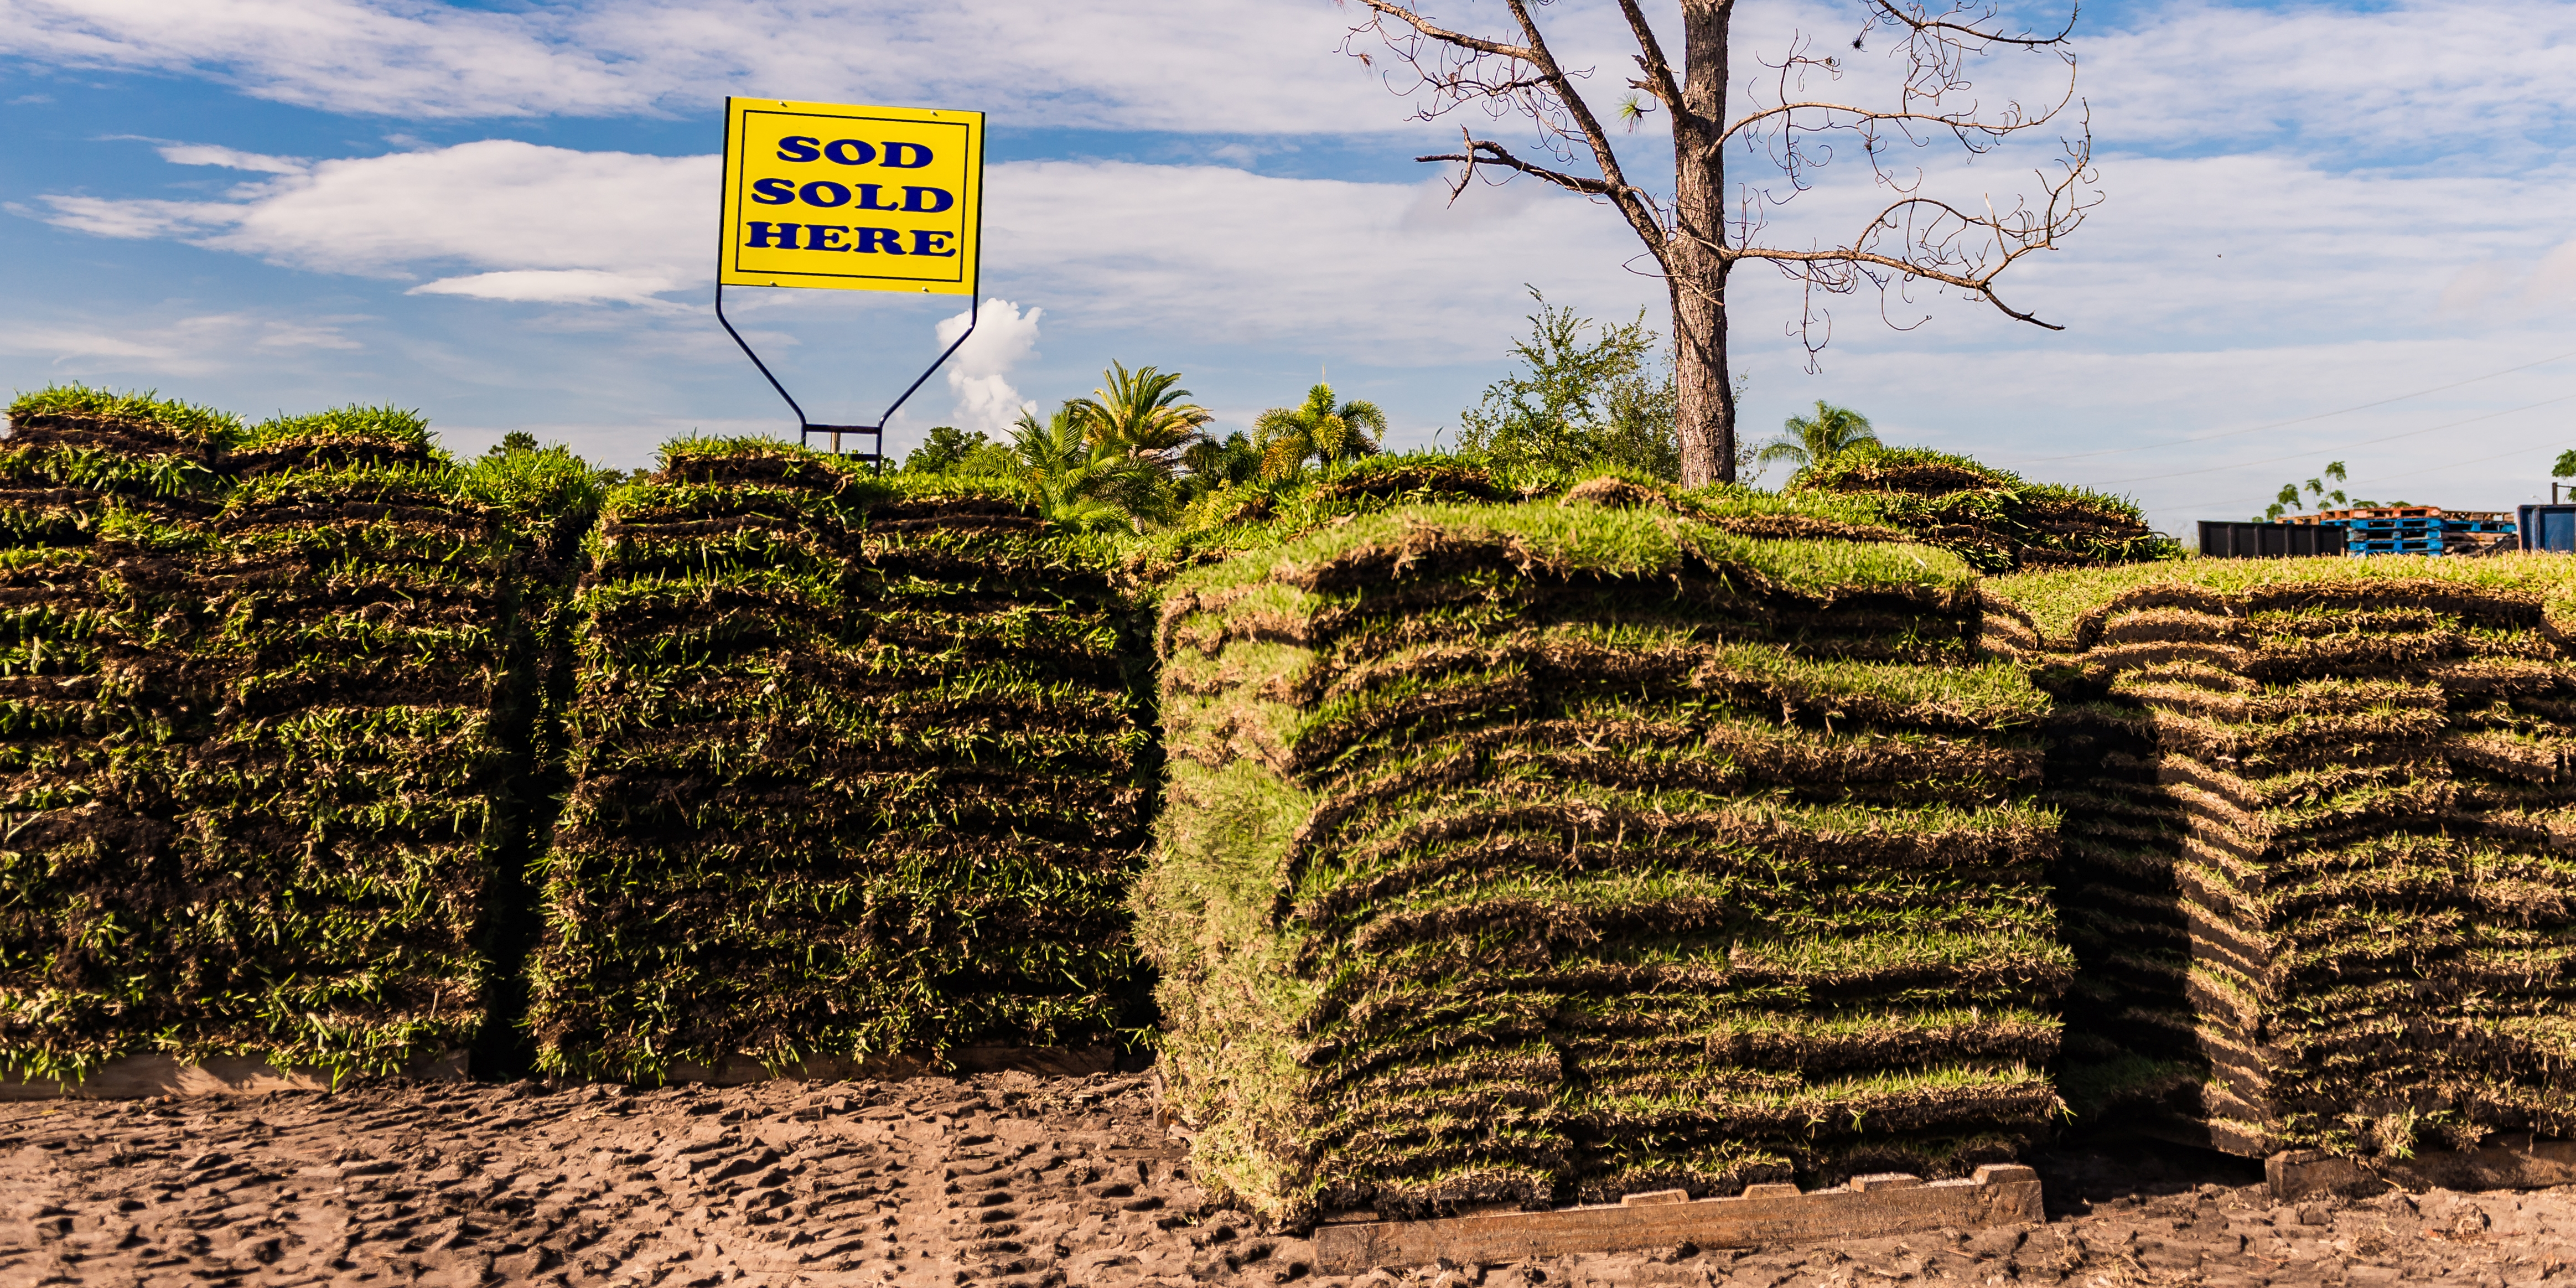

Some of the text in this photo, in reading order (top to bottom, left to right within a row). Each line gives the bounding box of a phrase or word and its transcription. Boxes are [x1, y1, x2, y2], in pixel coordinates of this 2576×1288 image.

[776, 136, 934, 169] SOD
[751, 178, 954, 213] SOLD
[744, 221, 956, 257] HERE
